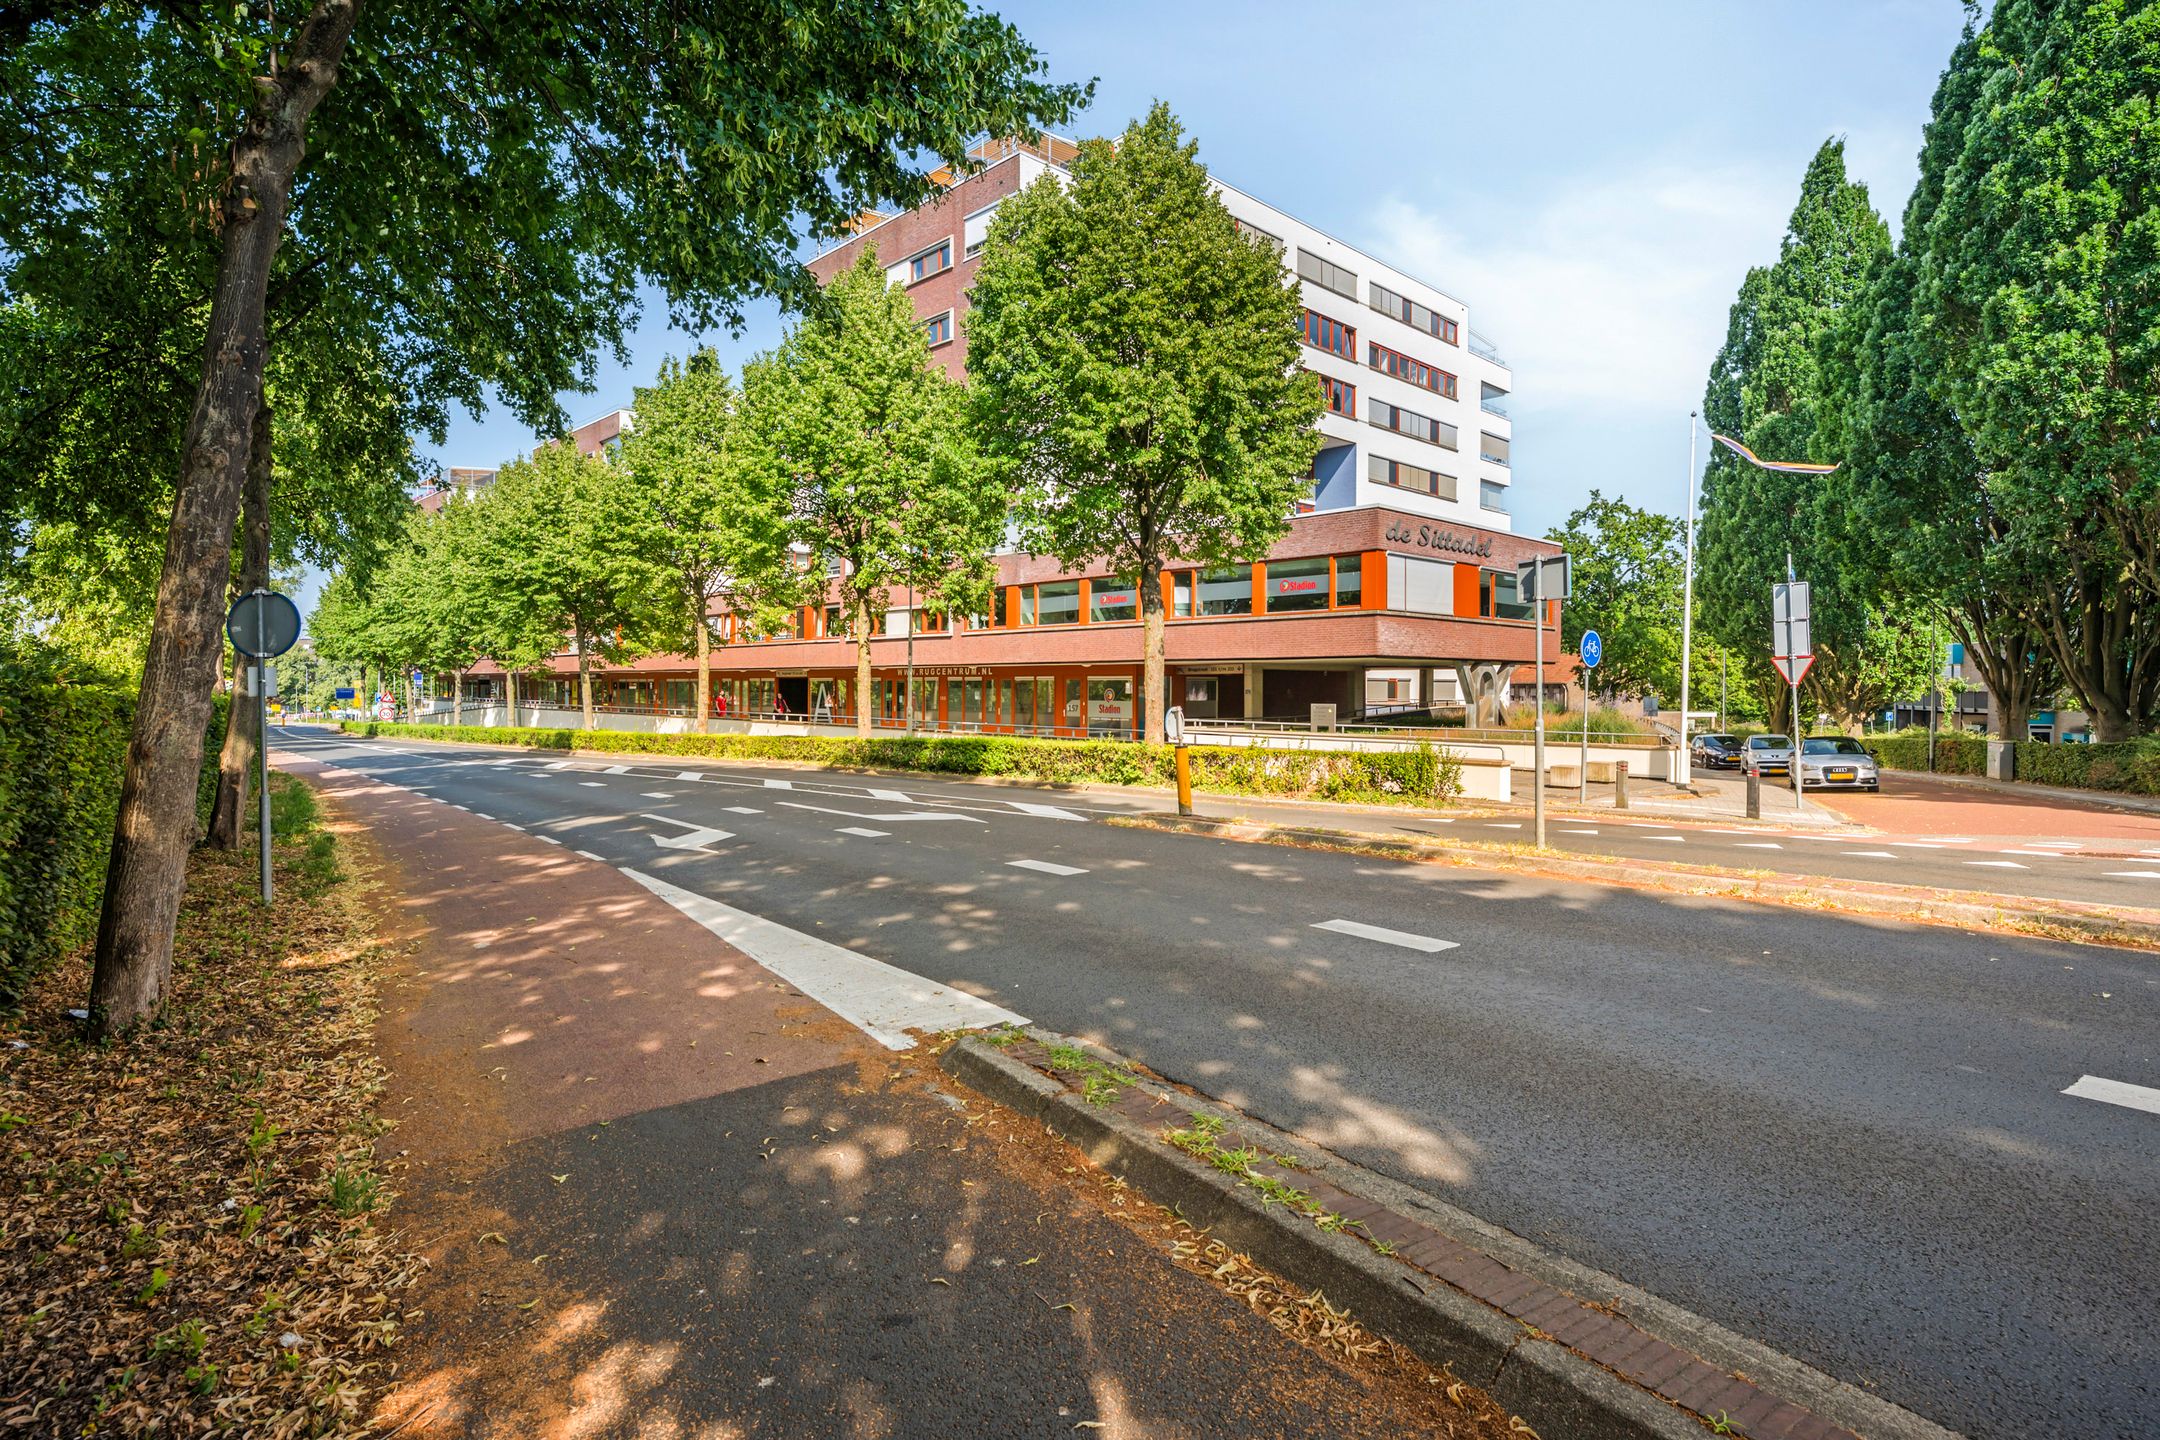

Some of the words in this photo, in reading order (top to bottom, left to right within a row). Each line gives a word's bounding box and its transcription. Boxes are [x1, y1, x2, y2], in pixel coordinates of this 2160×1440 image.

[1386, 518, 1411, 544] de
[1417, 524, 1492, 558] Sittadel
[1290, 581, 1316, 591] Stadion
[1098, 704, 1121, 713] Stadion
